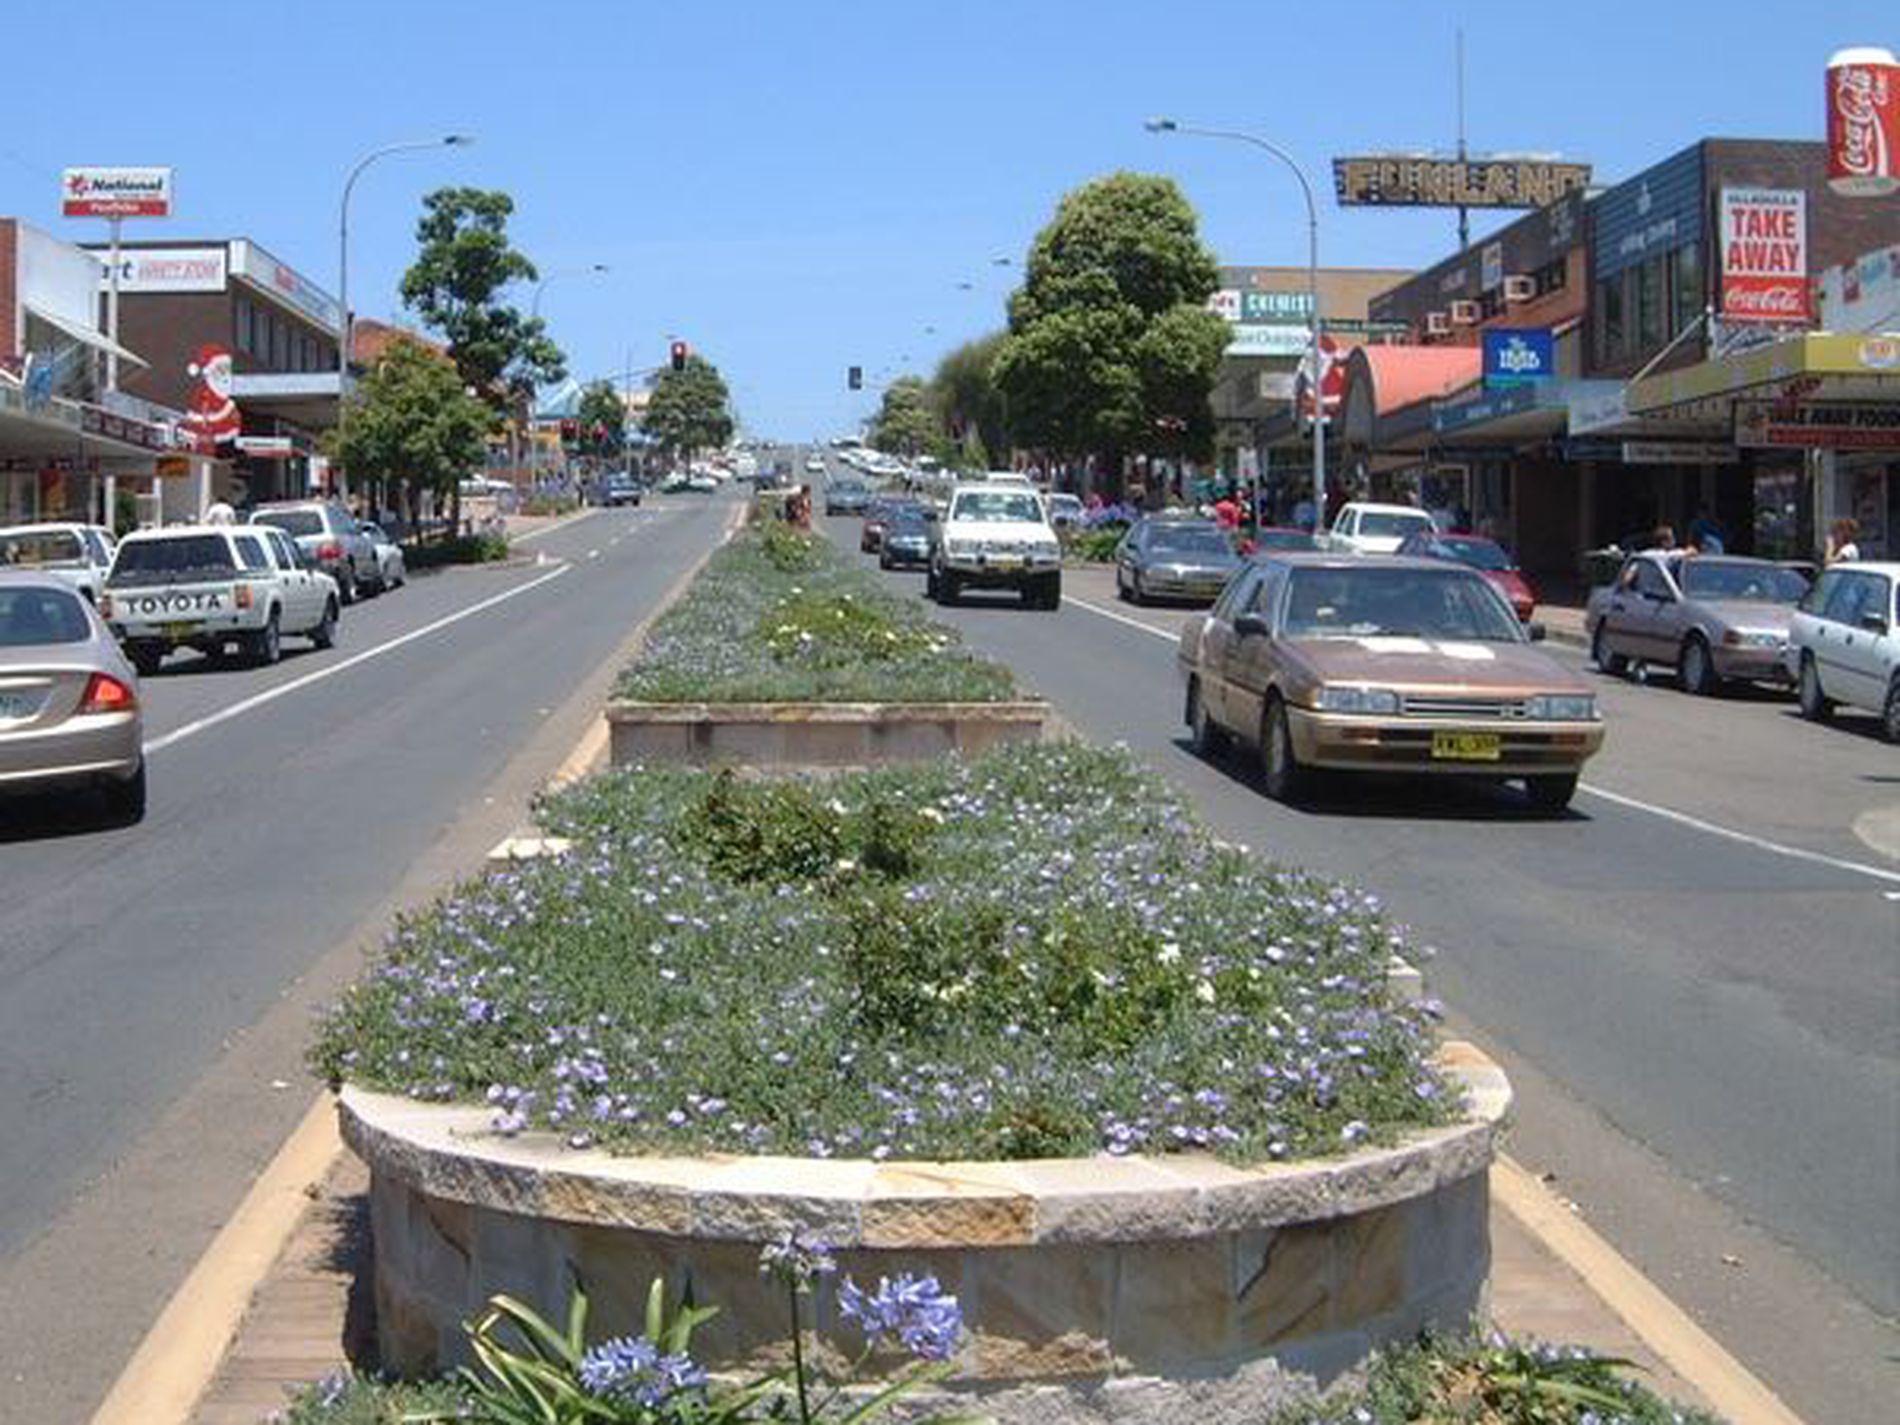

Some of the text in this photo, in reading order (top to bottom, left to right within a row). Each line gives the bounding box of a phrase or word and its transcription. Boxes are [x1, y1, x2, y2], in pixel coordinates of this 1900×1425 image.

[91, 176, 163, 191] National
[1732, 208, 1796, 238] TAKE
[1727, 242, 1799, 271] AWAY
[126, 594, 222, 615] TOYOTA
